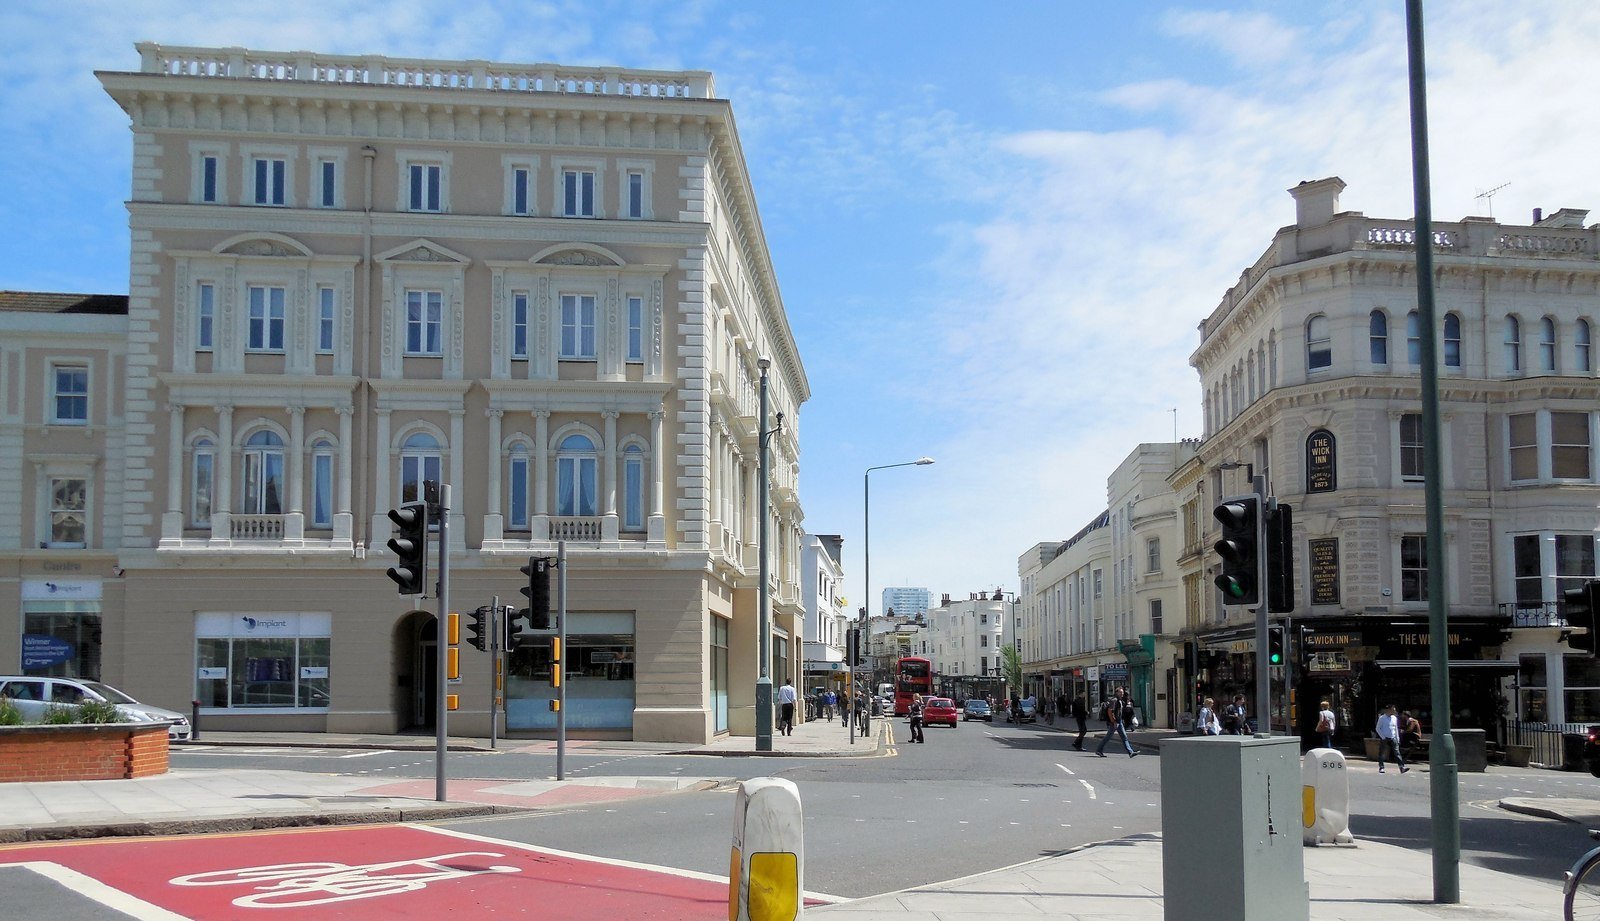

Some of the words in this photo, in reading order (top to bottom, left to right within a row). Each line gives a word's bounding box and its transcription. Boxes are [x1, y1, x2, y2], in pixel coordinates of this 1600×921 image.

[1313, 438, 1328, 446] THE
[1311, 446, 1330, 456] WICK
[1315, 455, 1327, 464] INN
[257, 620, 287, 629] Implant
[24, 638, 51, 646] Winner
[1314, 635, 1335, 645] WICK
[1336, 635, 1349, 644] INN
[1399, 633, 1417, 645] THE
[1322, 761, 1343, 769] 505
